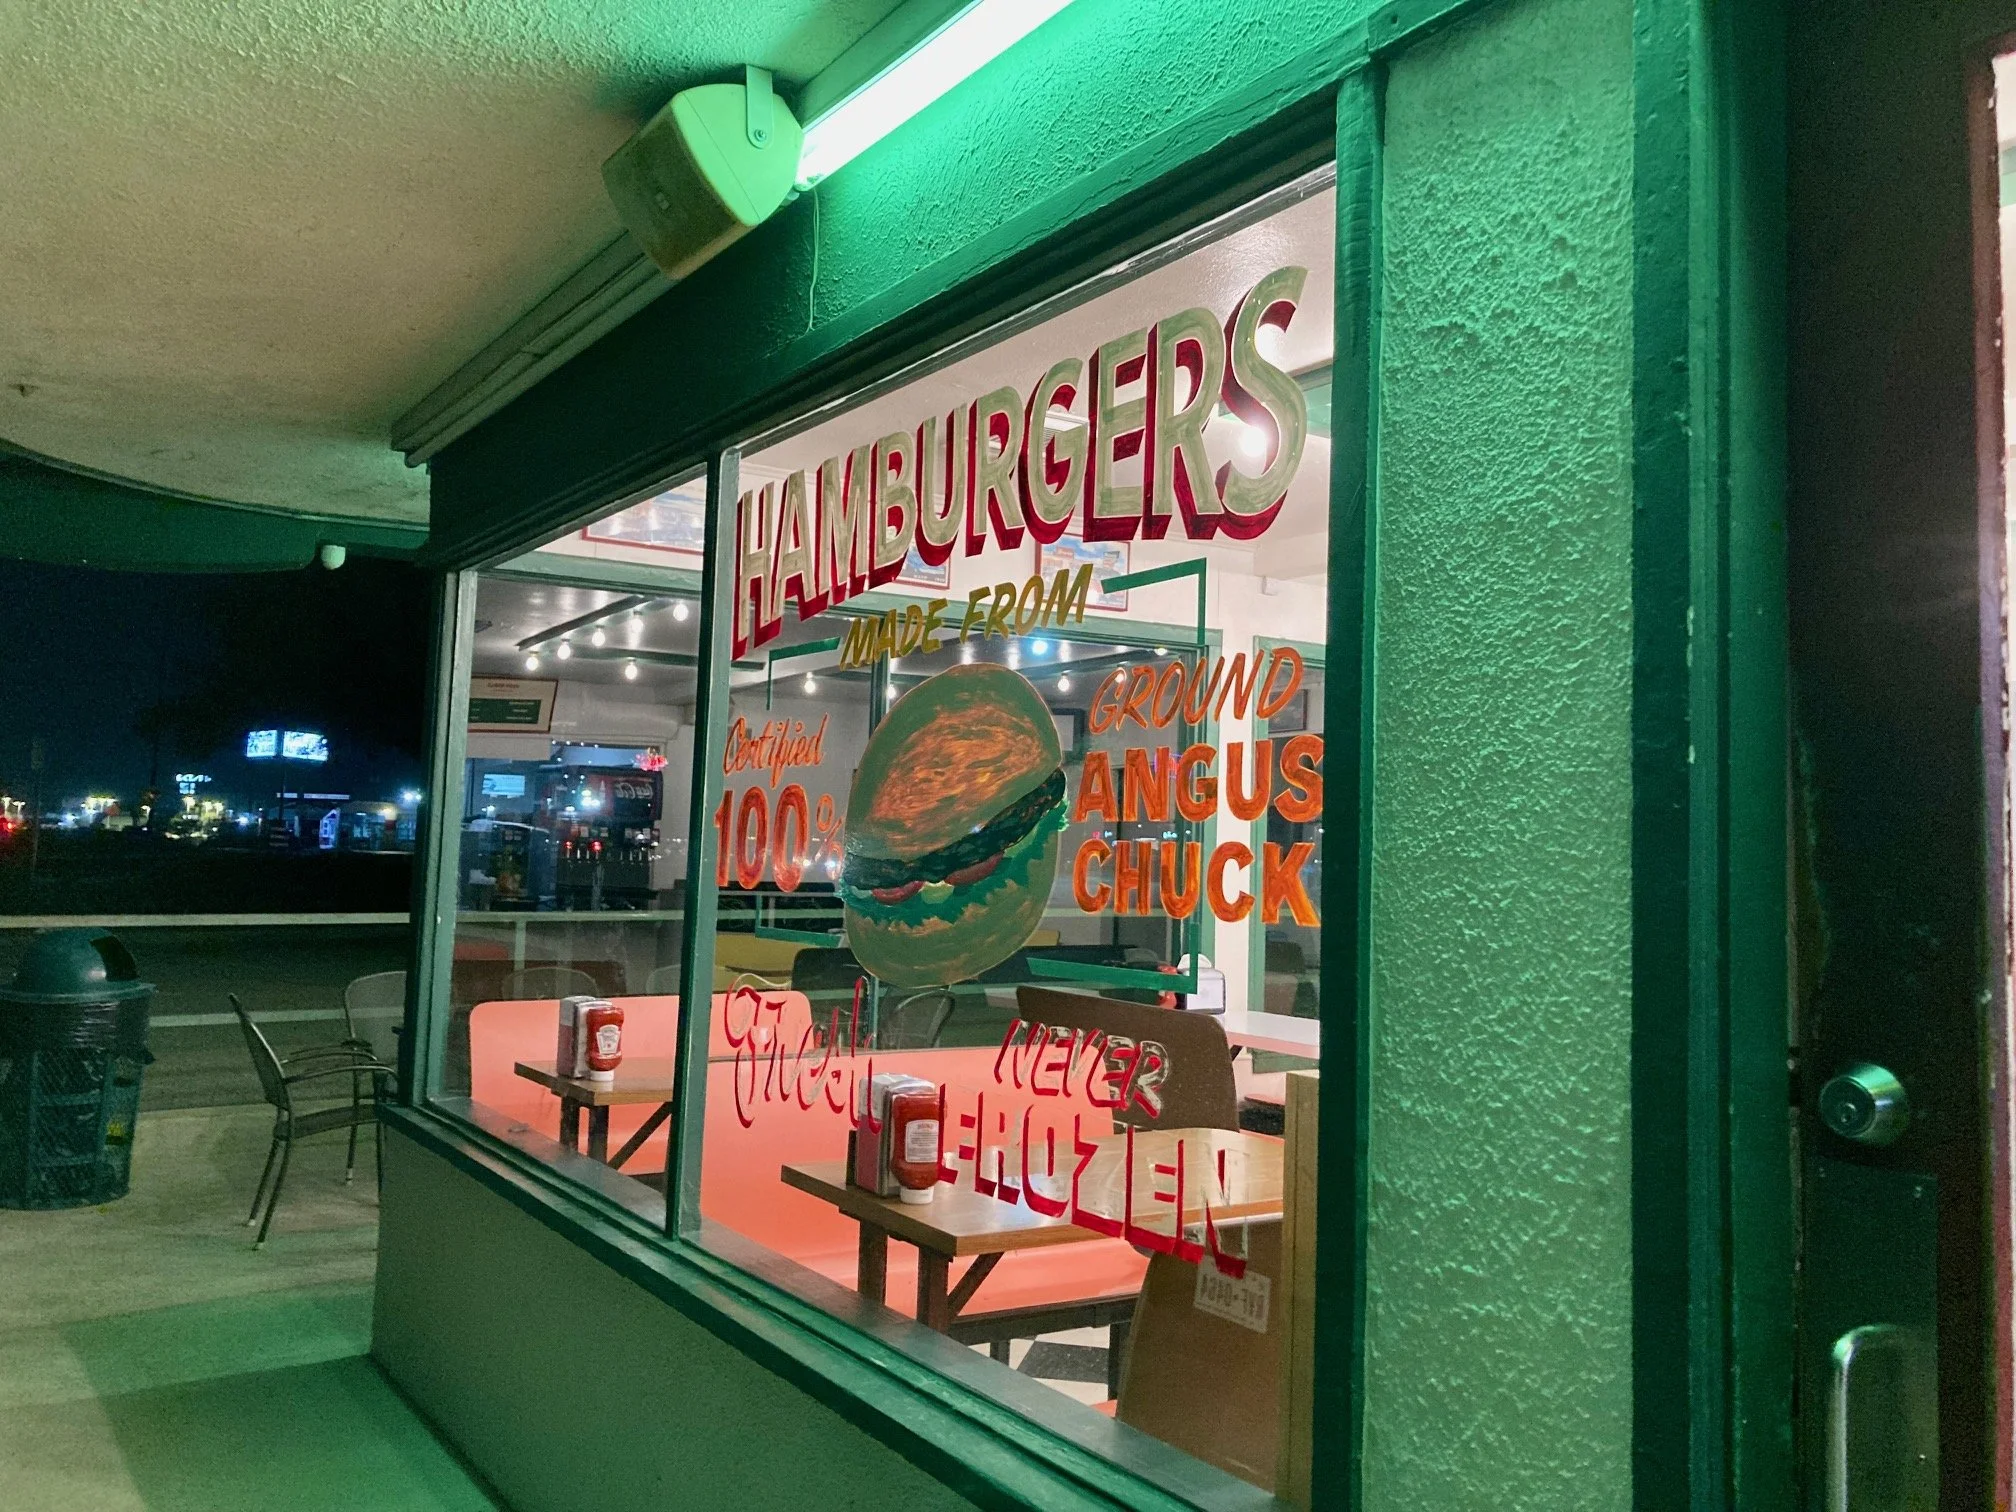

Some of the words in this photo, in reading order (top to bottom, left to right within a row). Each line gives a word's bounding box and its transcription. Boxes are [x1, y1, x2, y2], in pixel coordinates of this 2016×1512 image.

[732, 266, 1308, 660] HAMBURGERS
[840, 598, 948, 671] MADE
[959, 563, 1093, 645] FROM
[1088, 646, 1304, 736] GROUND
[723, 712, 829, 789] Certified
[1073, 734, 1324, 824] ANGUS
[714, 784, 844, 893] 100%
[1072, 838, 1321, 928] CHUCK
[994, 1018, 1170, 1119] NEVER
